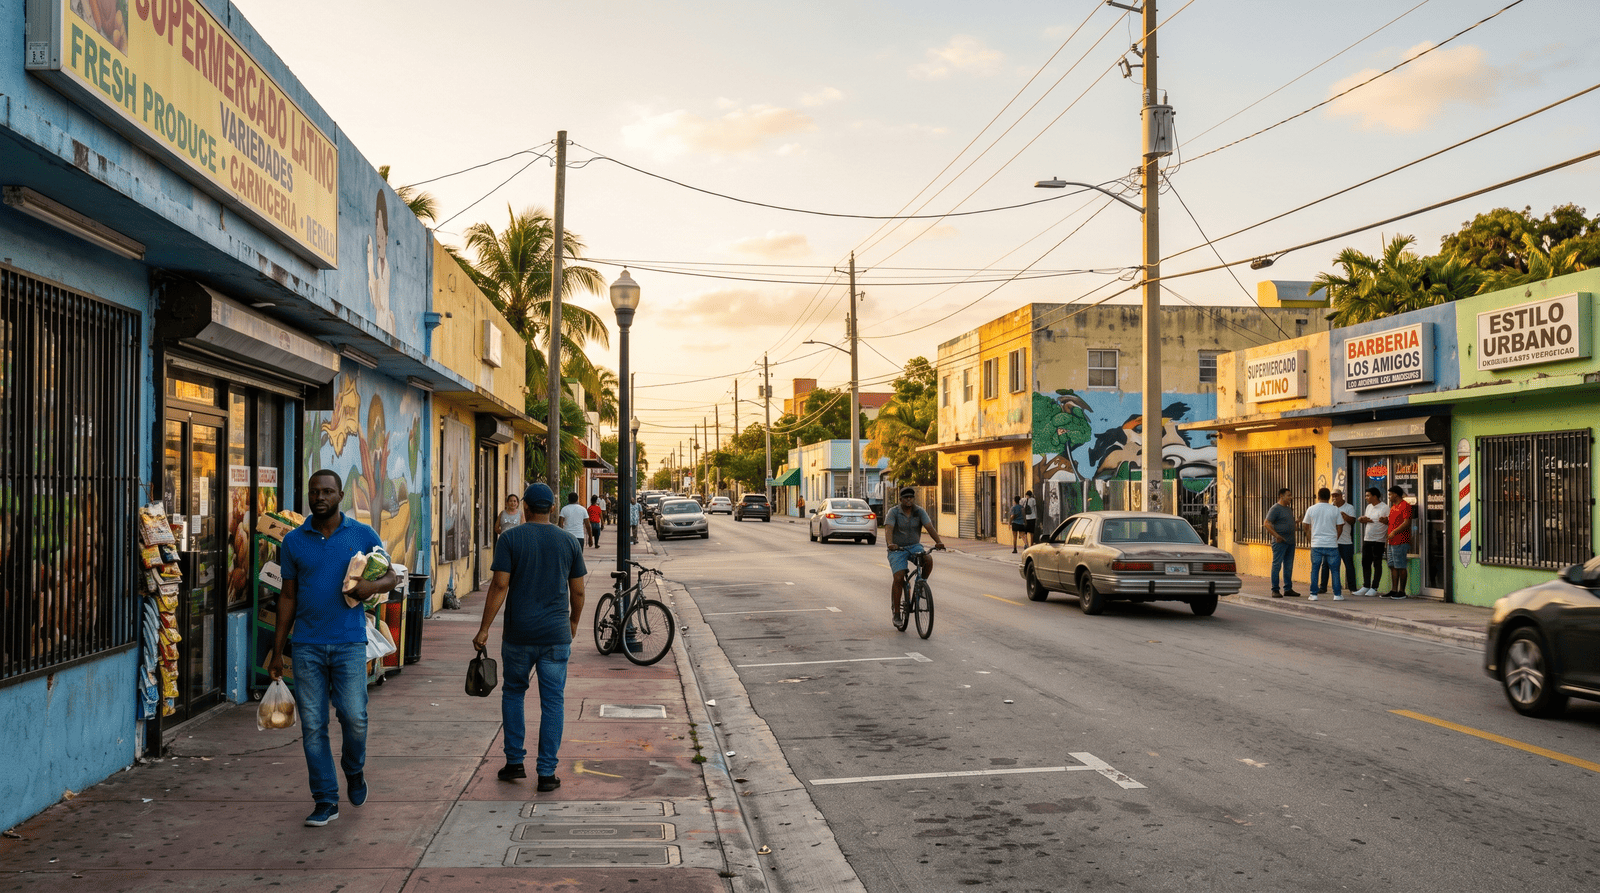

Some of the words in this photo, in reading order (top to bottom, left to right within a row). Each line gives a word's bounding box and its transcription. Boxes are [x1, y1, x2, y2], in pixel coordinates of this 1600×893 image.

[71, 22, 137, 114] FRESH
[143, 81, 217, 174] PRODUCE
[230, 155, 298, 234] CARNICERIA
[219, 100, 294, 193] VARIEDADES
[291, 109, 335, 195] LATINO
[1489, 302, 1564, 335] ESTILO
[1348, 329, 1419, 359] BARBERIA
[1483, 324, 1572, 357] URBANO
[1248, 356, 1296, 380] SUPERMERCADO
[1347, 360, 1369, 377] LOS
[1372, 350, 1420, 374] AMIGOS
[1255, 377, 1289, 397] LATINO
